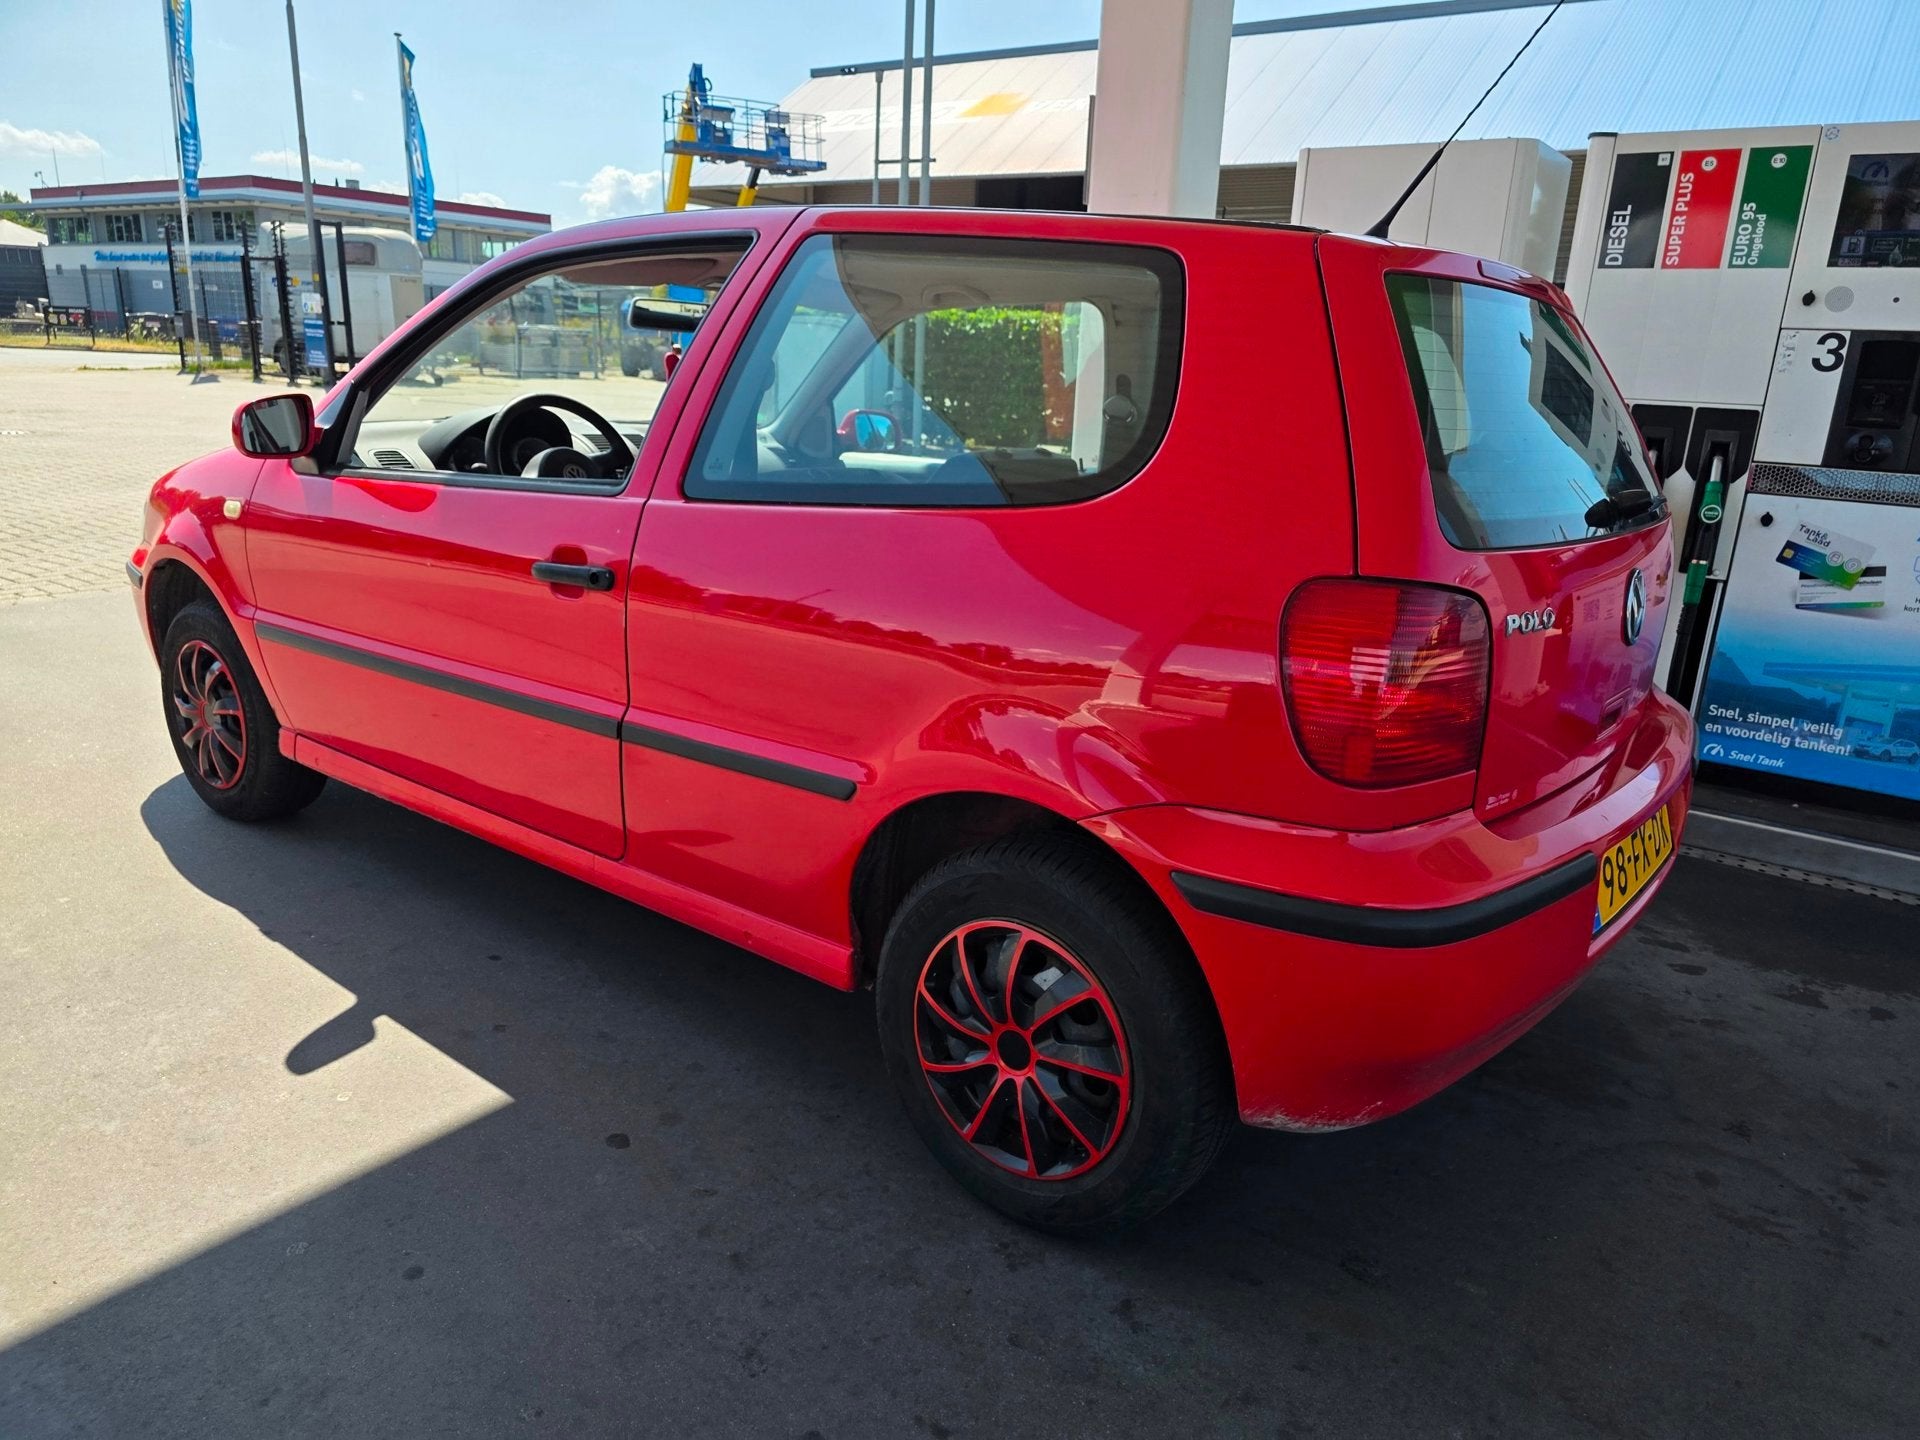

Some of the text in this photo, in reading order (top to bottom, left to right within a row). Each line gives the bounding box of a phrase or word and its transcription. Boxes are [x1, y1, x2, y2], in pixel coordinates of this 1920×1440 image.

[1604, 204, 1632, 265] DIESEL
[1665, 172, 1694, 266] SUPER PLUS
[1732, 202, 1757, 265] EURO 95
[1747, 214, 1767, 266] Ongelood
[1811, 332, 1847, 372] 3
[1806, 531, 1832, 548] Laad
[1506, 607, 1556, 636] POLO
[1705, 723, 1851, 757] en voordelig tanken!
[1708, 704, 1843, 740] Snel, simpel, veilig
[1728, 750, 1785, 768] Snel Tank
